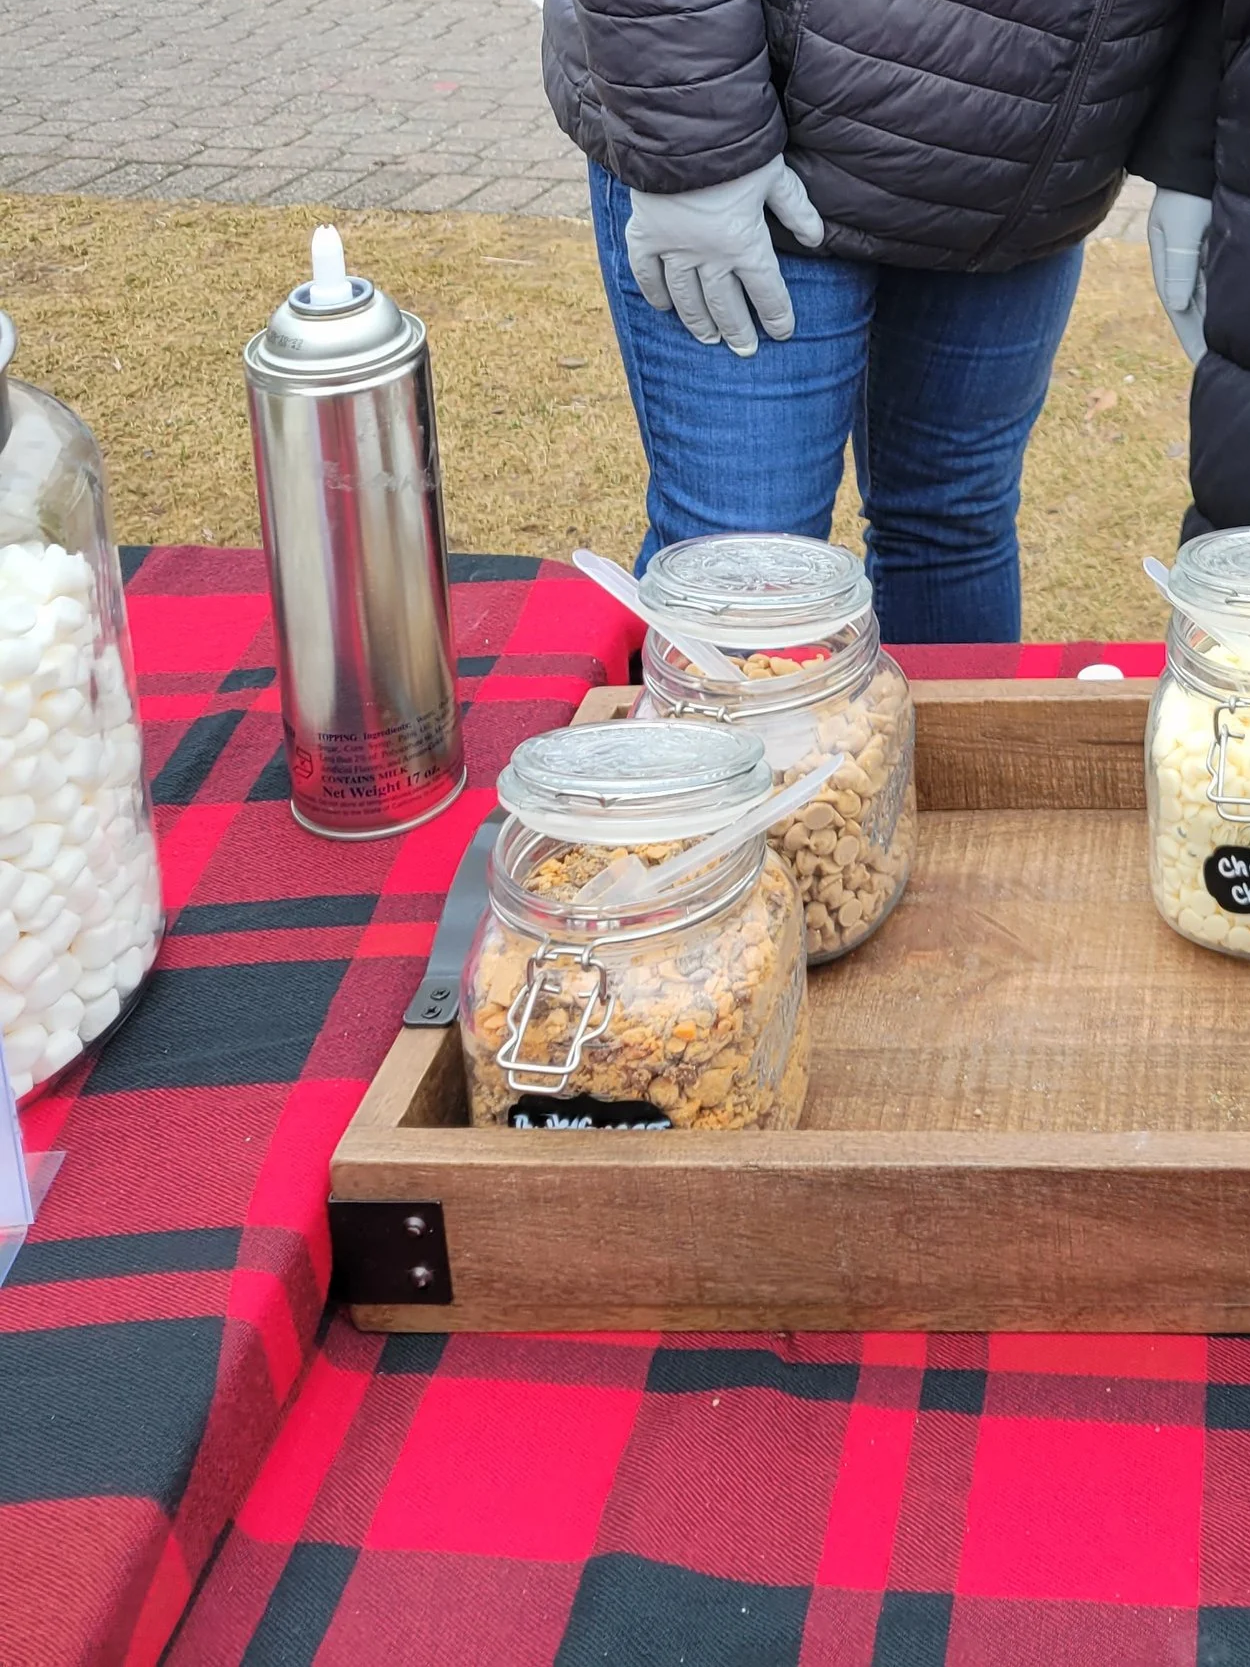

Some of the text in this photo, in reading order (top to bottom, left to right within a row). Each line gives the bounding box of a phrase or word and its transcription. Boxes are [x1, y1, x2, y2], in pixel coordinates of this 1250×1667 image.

[318, 732, 358, 743] TOPPING
[321, 774, 376, 784] CONTAINS
[379, 766, 408, 780] MILK
[322, 786, 346, 799] Net
[349, 779, 402, 798] Weight
[407, 772, 420, 787] 17
